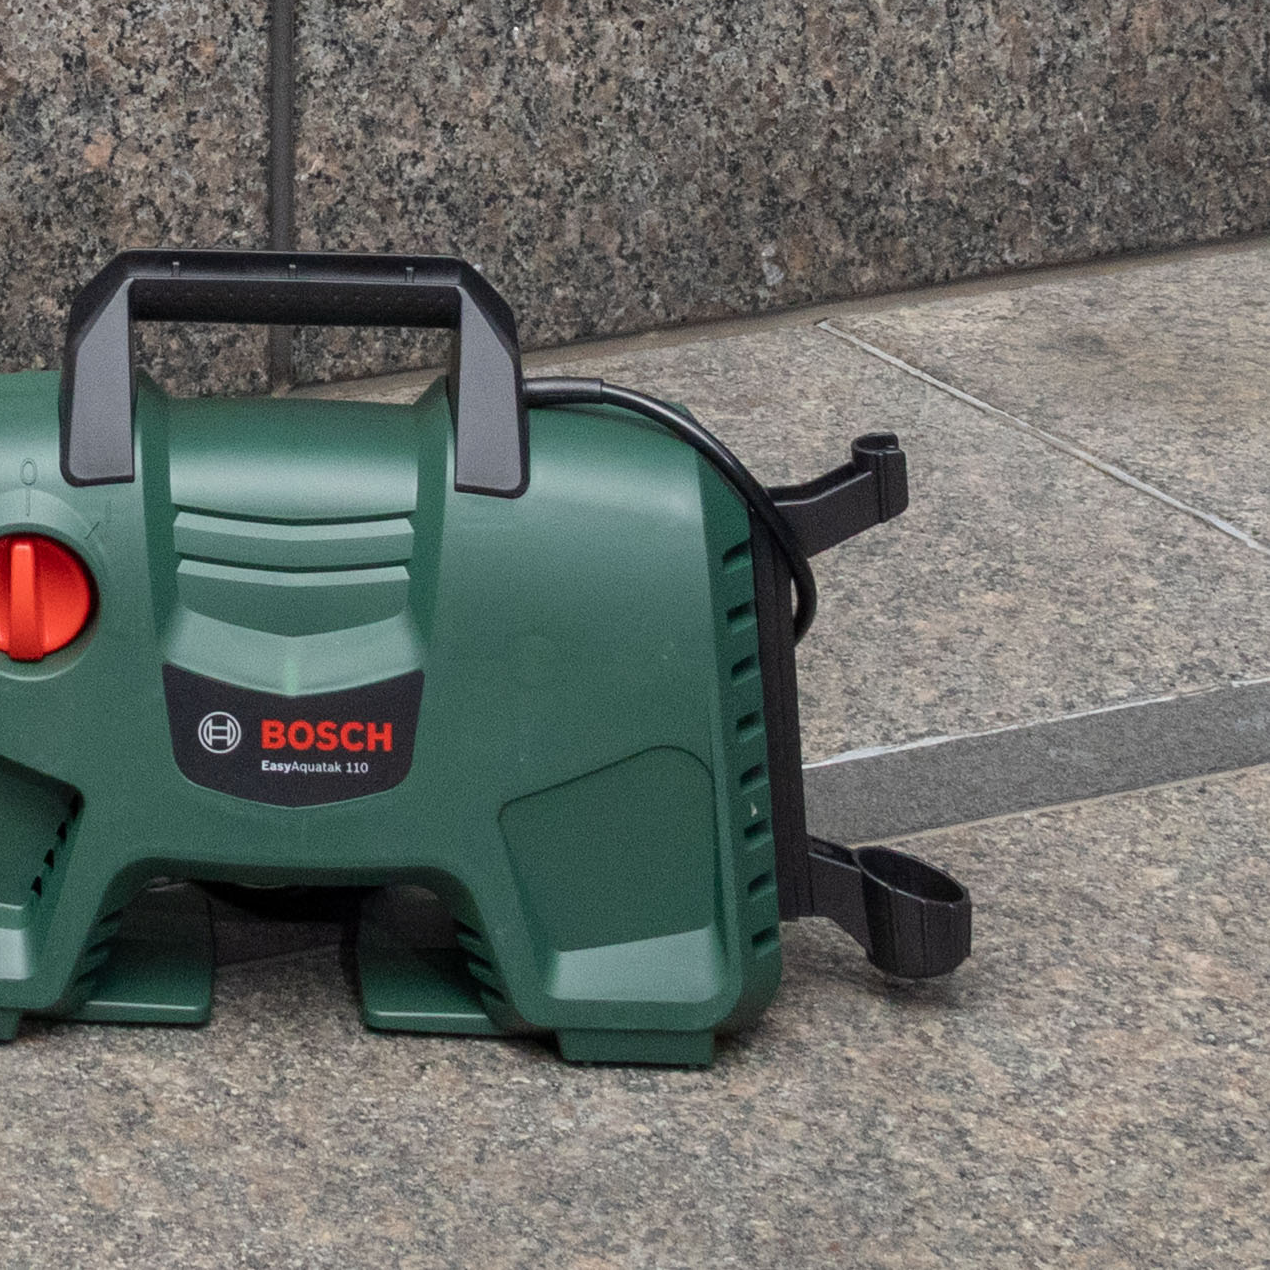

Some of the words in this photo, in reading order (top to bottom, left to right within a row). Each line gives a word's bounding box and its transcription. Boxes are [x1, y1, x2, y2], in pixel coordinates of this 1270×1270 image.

[261, 719, 393, 752] BOSCH
[261, 760, 342, 774] EasyAquatak
[345, 762, 369, 774] 110
